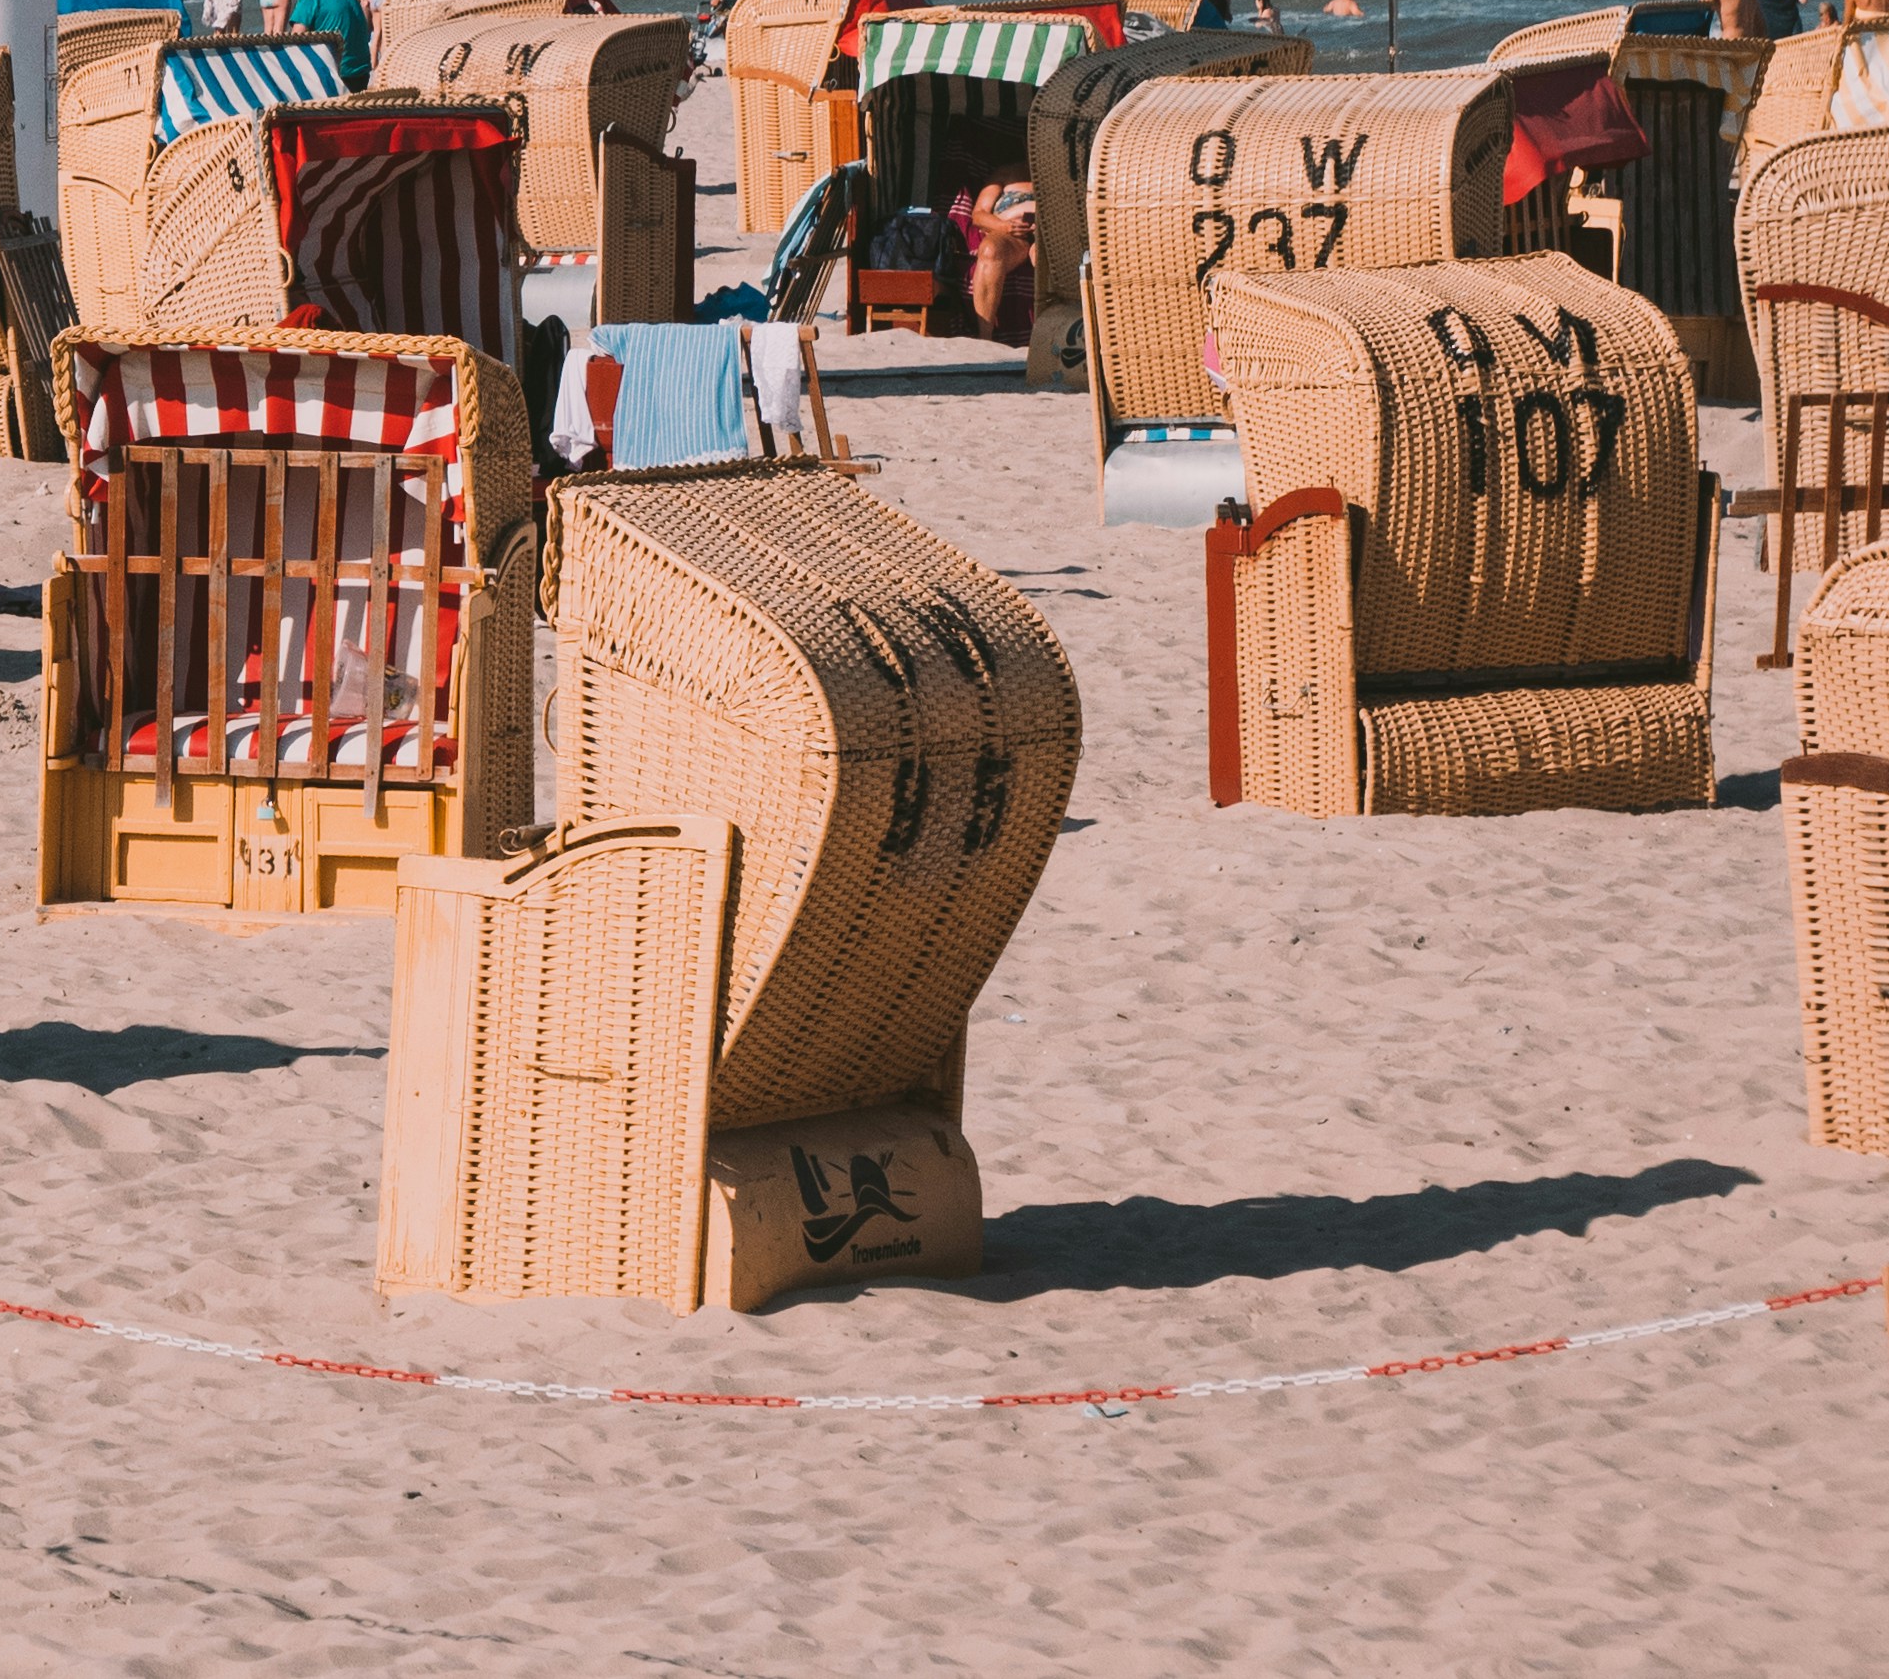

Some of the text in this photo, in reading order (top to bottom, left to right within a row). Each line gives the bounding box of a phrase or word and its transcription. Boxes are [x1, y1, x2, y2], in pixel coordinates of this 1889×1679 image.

[1300, 133, 1370, 192] W
[1192, 202, 1348, 283] 237
[1514, 304, 1600, 367] W
[1458, 390, 1626, 500] 107
[851, 1236, 922, 1265] Travemünde
